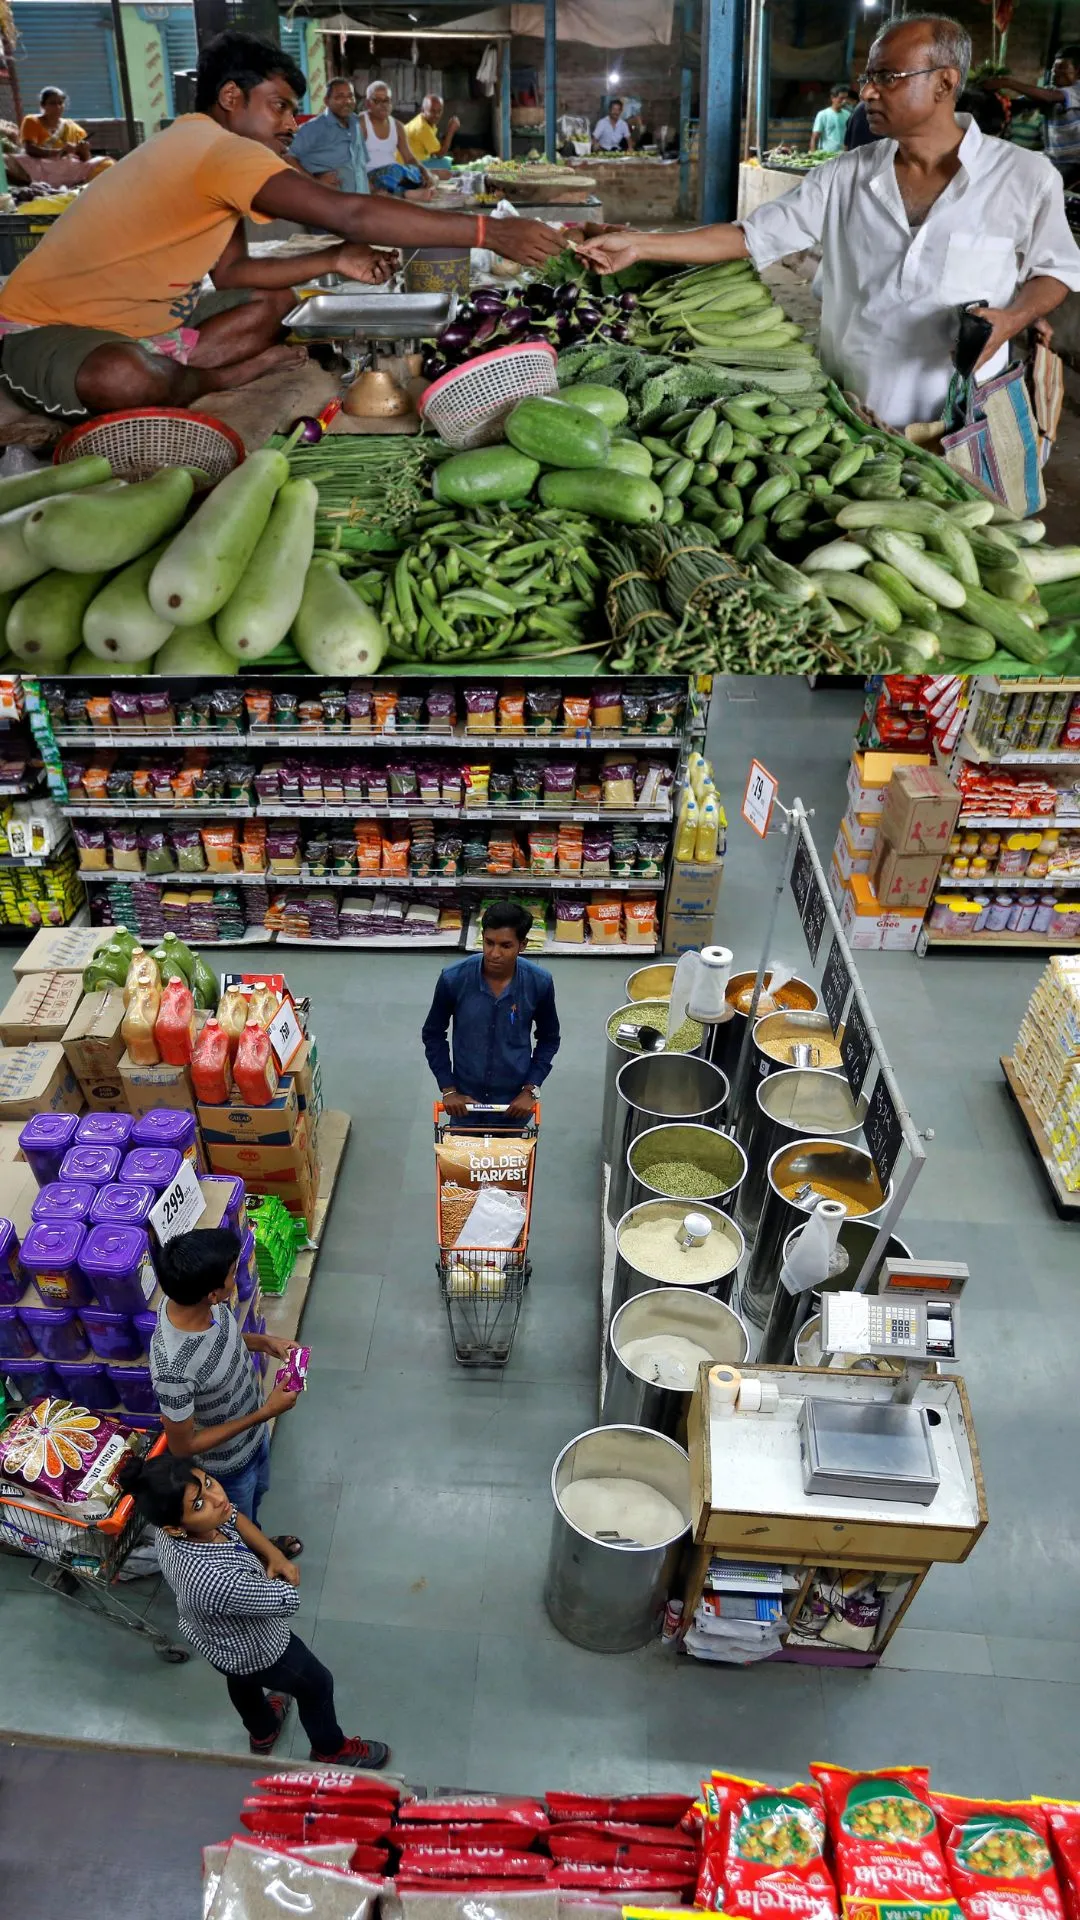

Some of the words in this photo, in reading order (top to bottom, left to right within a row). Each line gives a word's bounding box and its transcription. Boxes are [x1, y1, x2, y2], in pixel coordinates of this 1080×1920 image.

[753, 775, 764, 801] 79
[876, 920, 900, 929] Ghee
[469, 1154, 528, 1169] GOLDEN
[470, 1168, 527, 1182] HARVEST
[163, 1184, 185, 1225] 299
[97, 1443, 118, 1467] CHANA
[273, 1772, 354, 1789] GOLDEN
[853, 1864, 943, 1894] Nutrela
[736, 1889, 832, 1916] Nutrela
